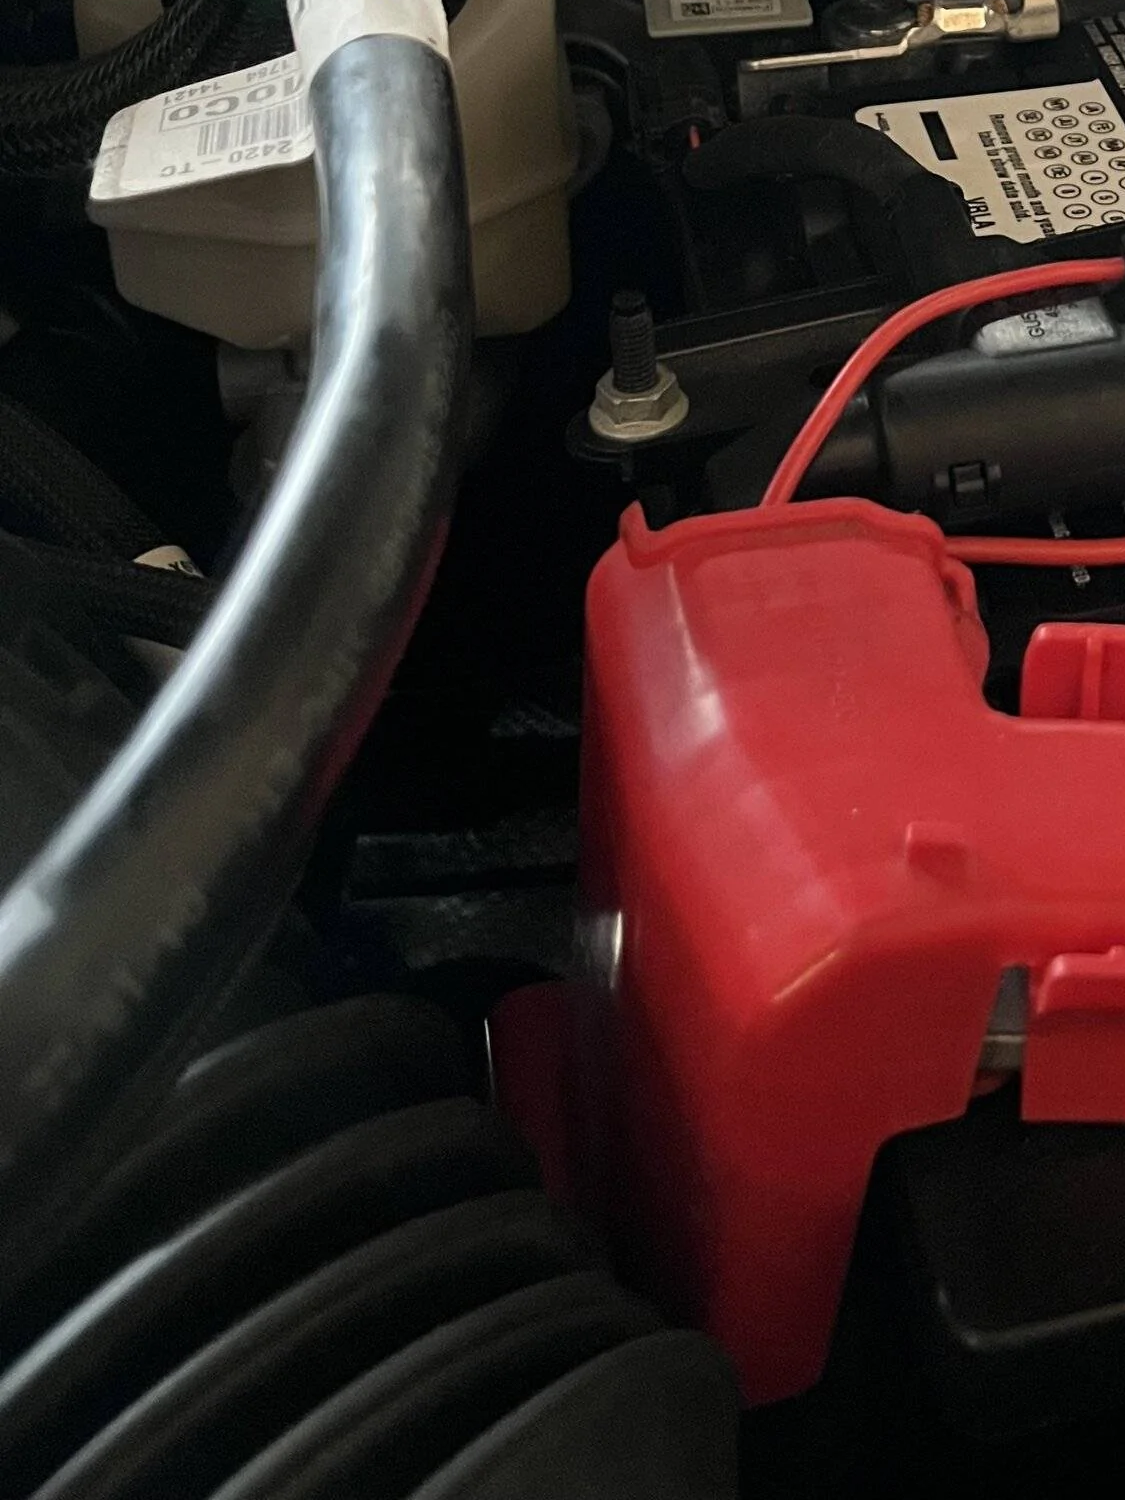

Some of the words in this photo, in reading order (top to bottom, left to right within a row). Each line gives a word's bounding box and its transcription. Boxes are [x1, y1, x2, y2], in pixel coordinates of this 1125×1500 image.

[229, 140, 292, 164] 2420
[161, 162, 194, 178] TC
[1001, 180, 1019, 199] date
[966, 196, 996, 230] VRLA
[1030, 200, 1051, 215] and
